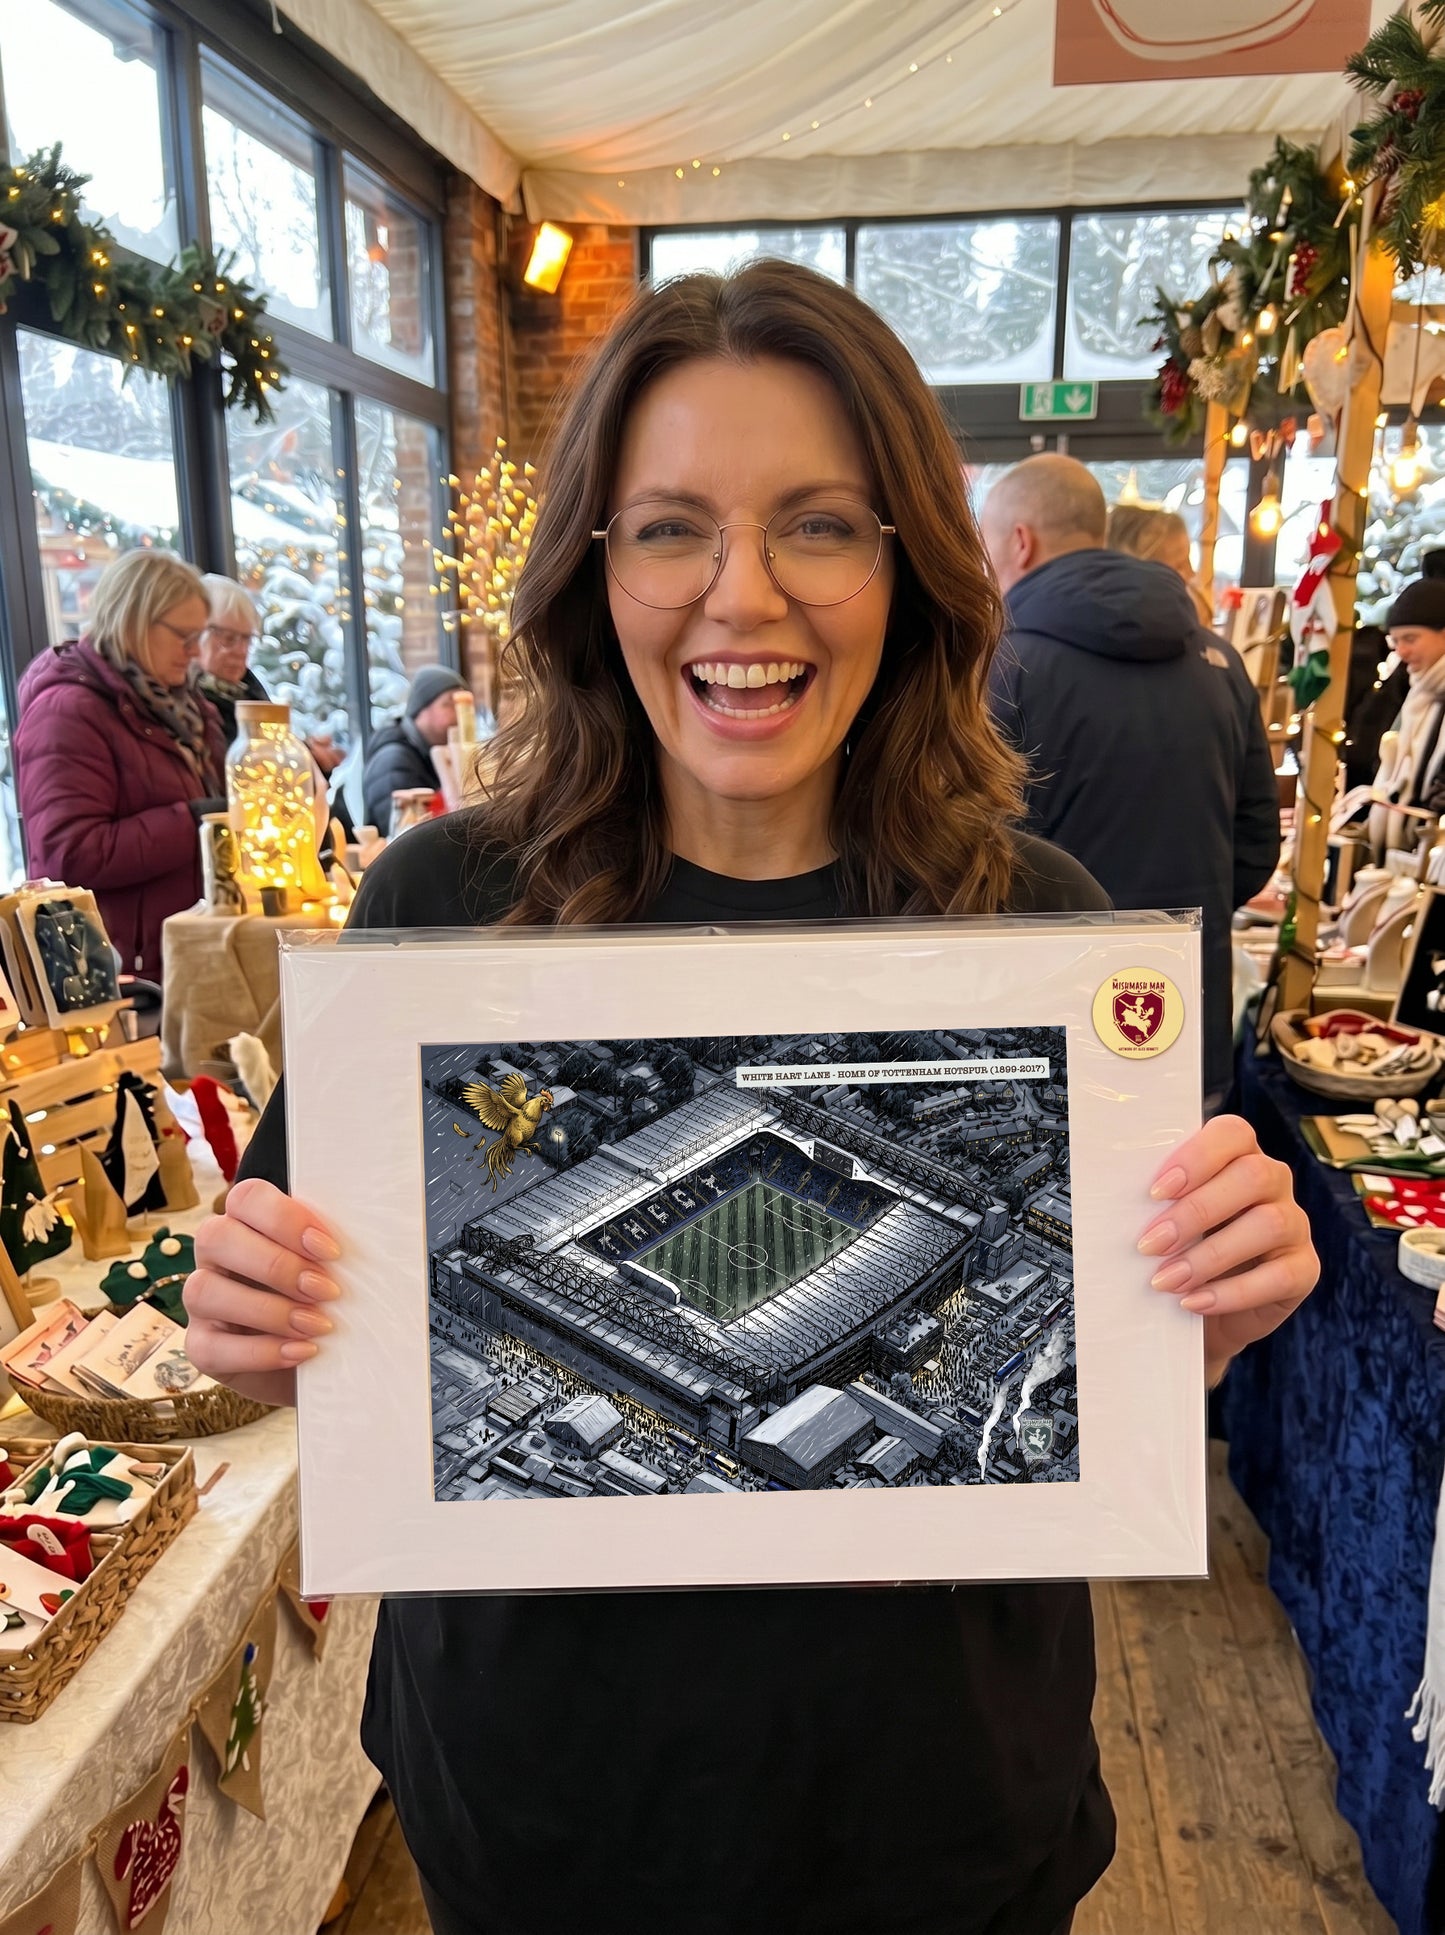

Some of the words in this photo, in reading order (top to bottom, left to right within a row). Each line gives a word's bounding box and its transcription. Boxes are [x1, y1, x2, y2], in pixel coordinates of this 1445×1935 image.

[1112, 981, 1148, 990] MISHMASH
[1149, 981, 1165, 990] MAN
[741, 1073, 773, 1081] WHITE
[775, 1072, 802, 1080] HART
[804, 1071, 831, 1080] LANE
[838, 1070, 866, 1079] HOME
[868, 1069, 880, 1078] OF
[882, 1067, 942, 1077] TOTTENHAM
[943, 1066, 988, 1075] HOTSPUR
[989, 1064, 1046, 1075] (1899-2017)
